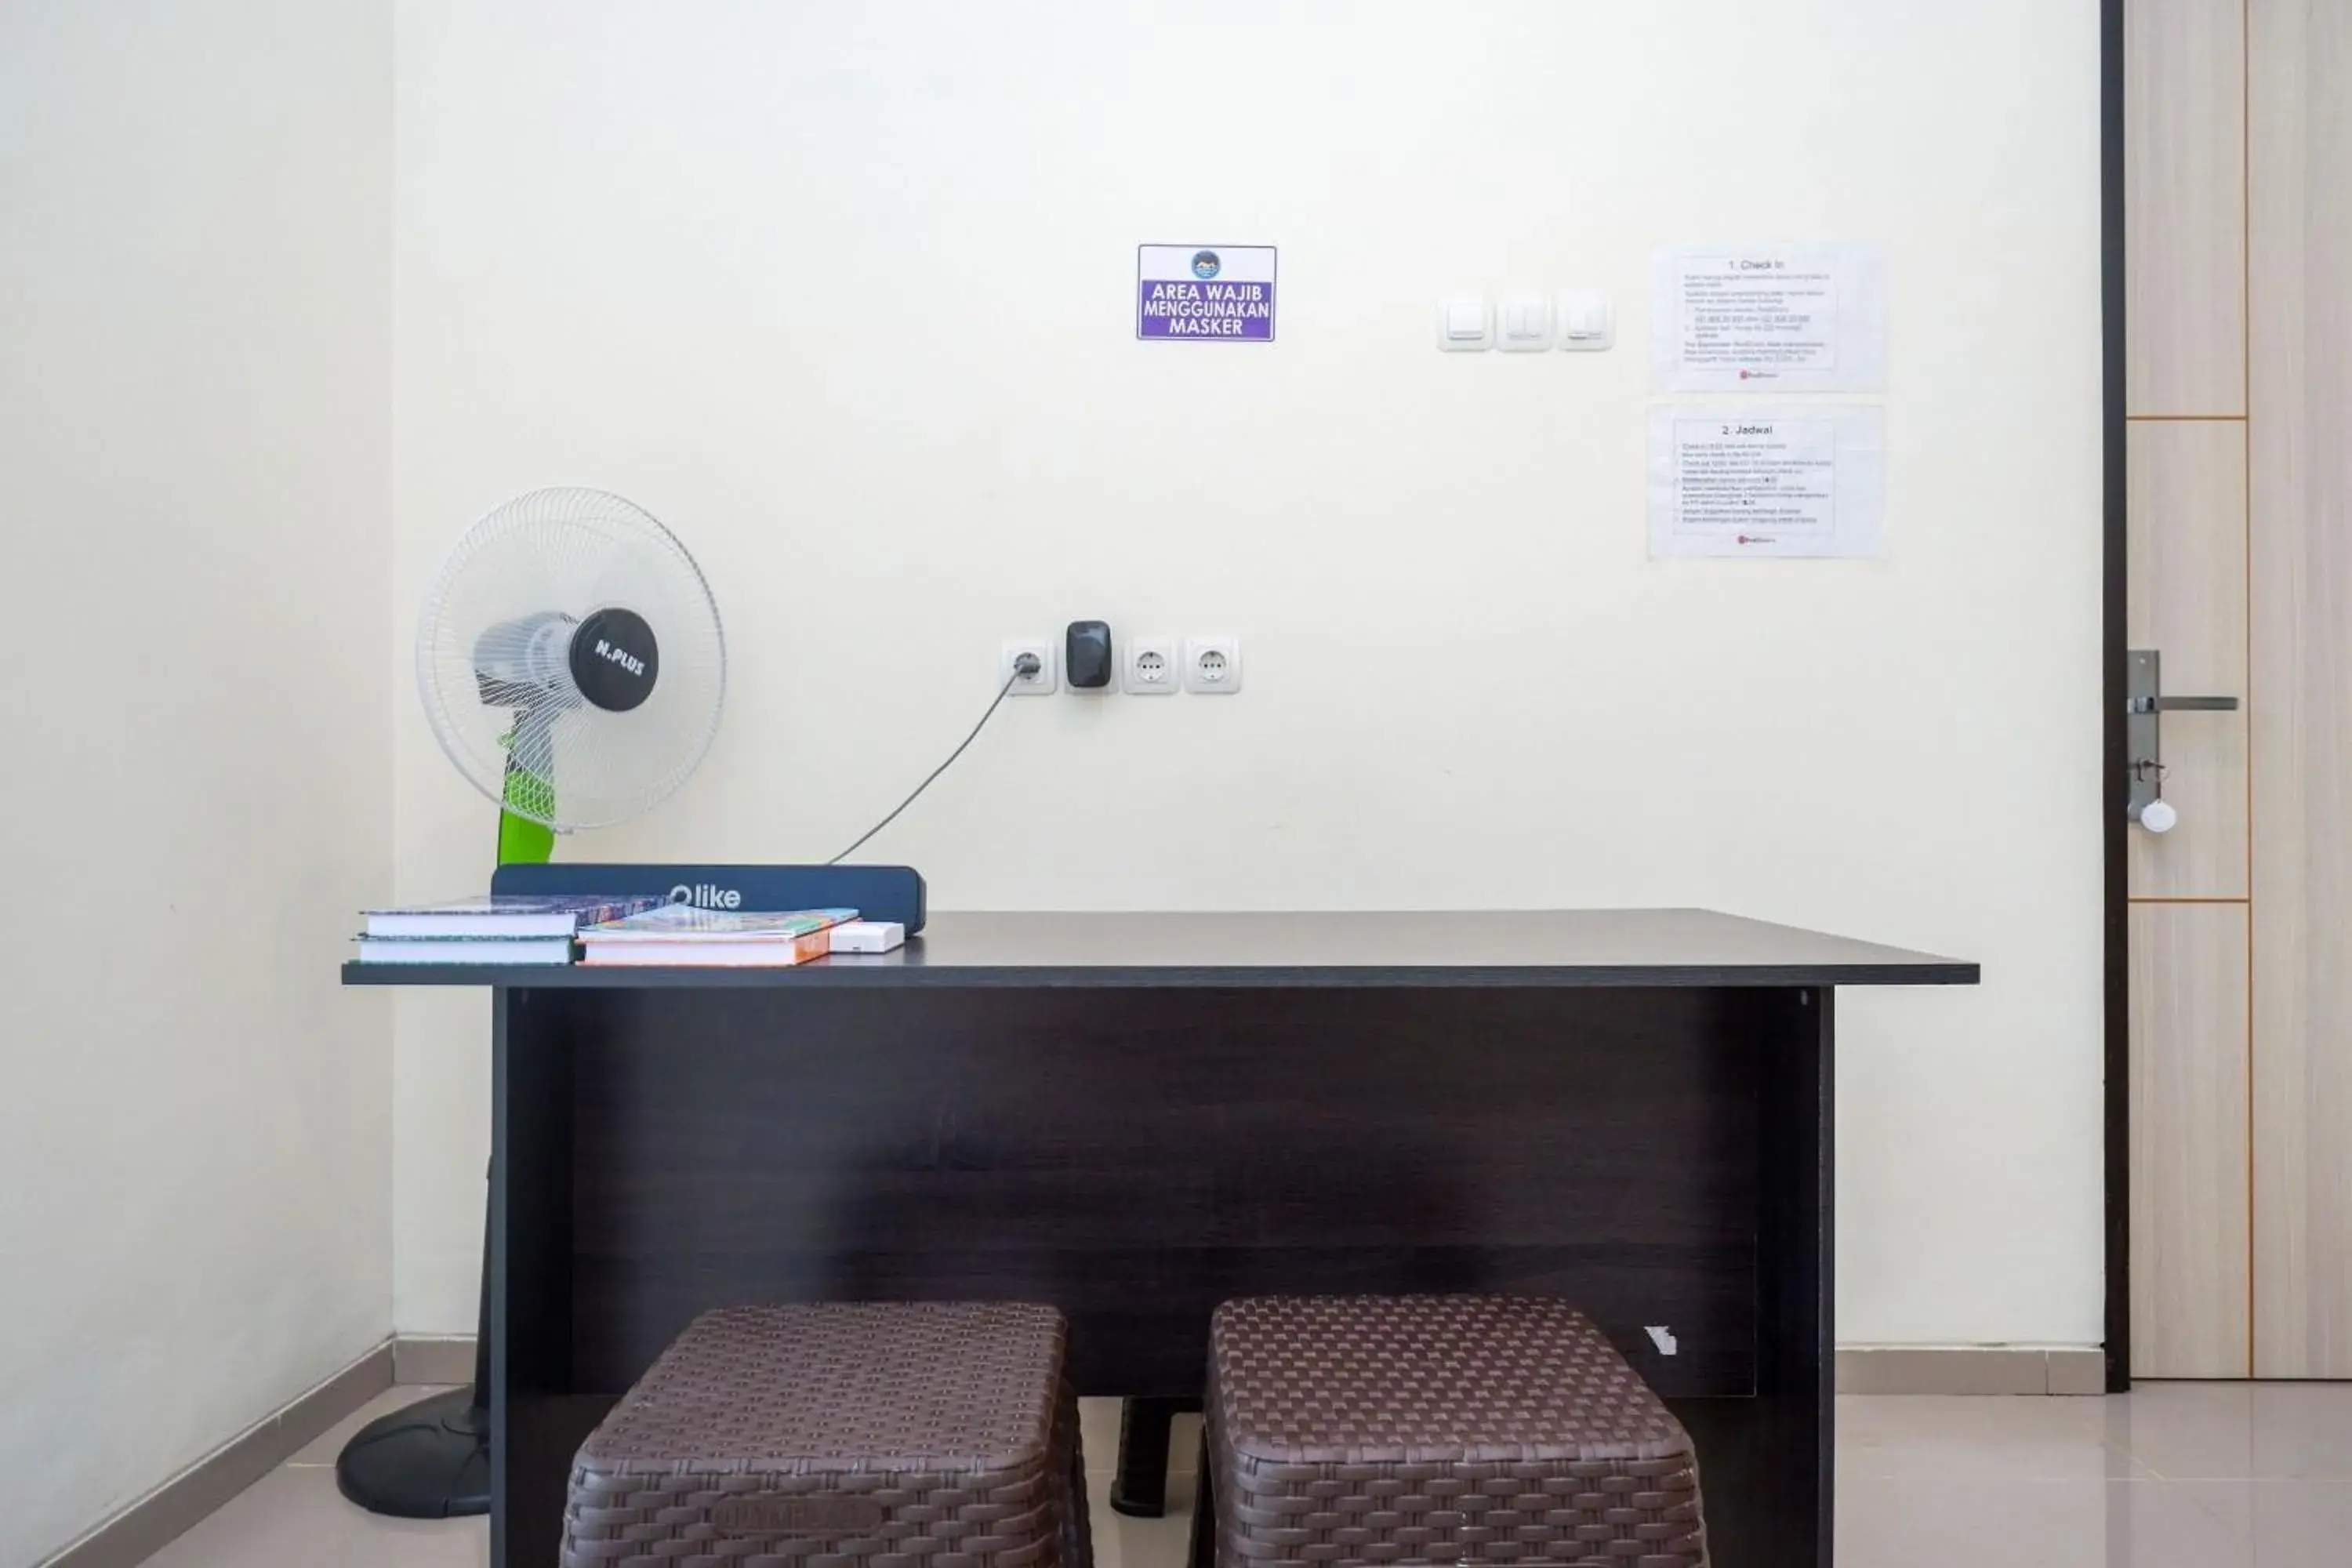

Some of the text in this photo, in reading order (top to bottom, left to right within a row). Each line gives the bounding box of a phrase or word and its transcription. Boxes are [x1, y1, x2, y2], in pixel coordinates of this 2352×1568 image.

[1740, 259, 1771, 270] Check
[1152, 283, 1263, 302] AREA WAJIB
[1144, 300, 1269, 318] MENGGUNAKAN
[1169, 318, 1243, 336] MASKER
[1735, 424, 1773, 435] Jadwal
[595, 639, 645, 677] N.PLUS
